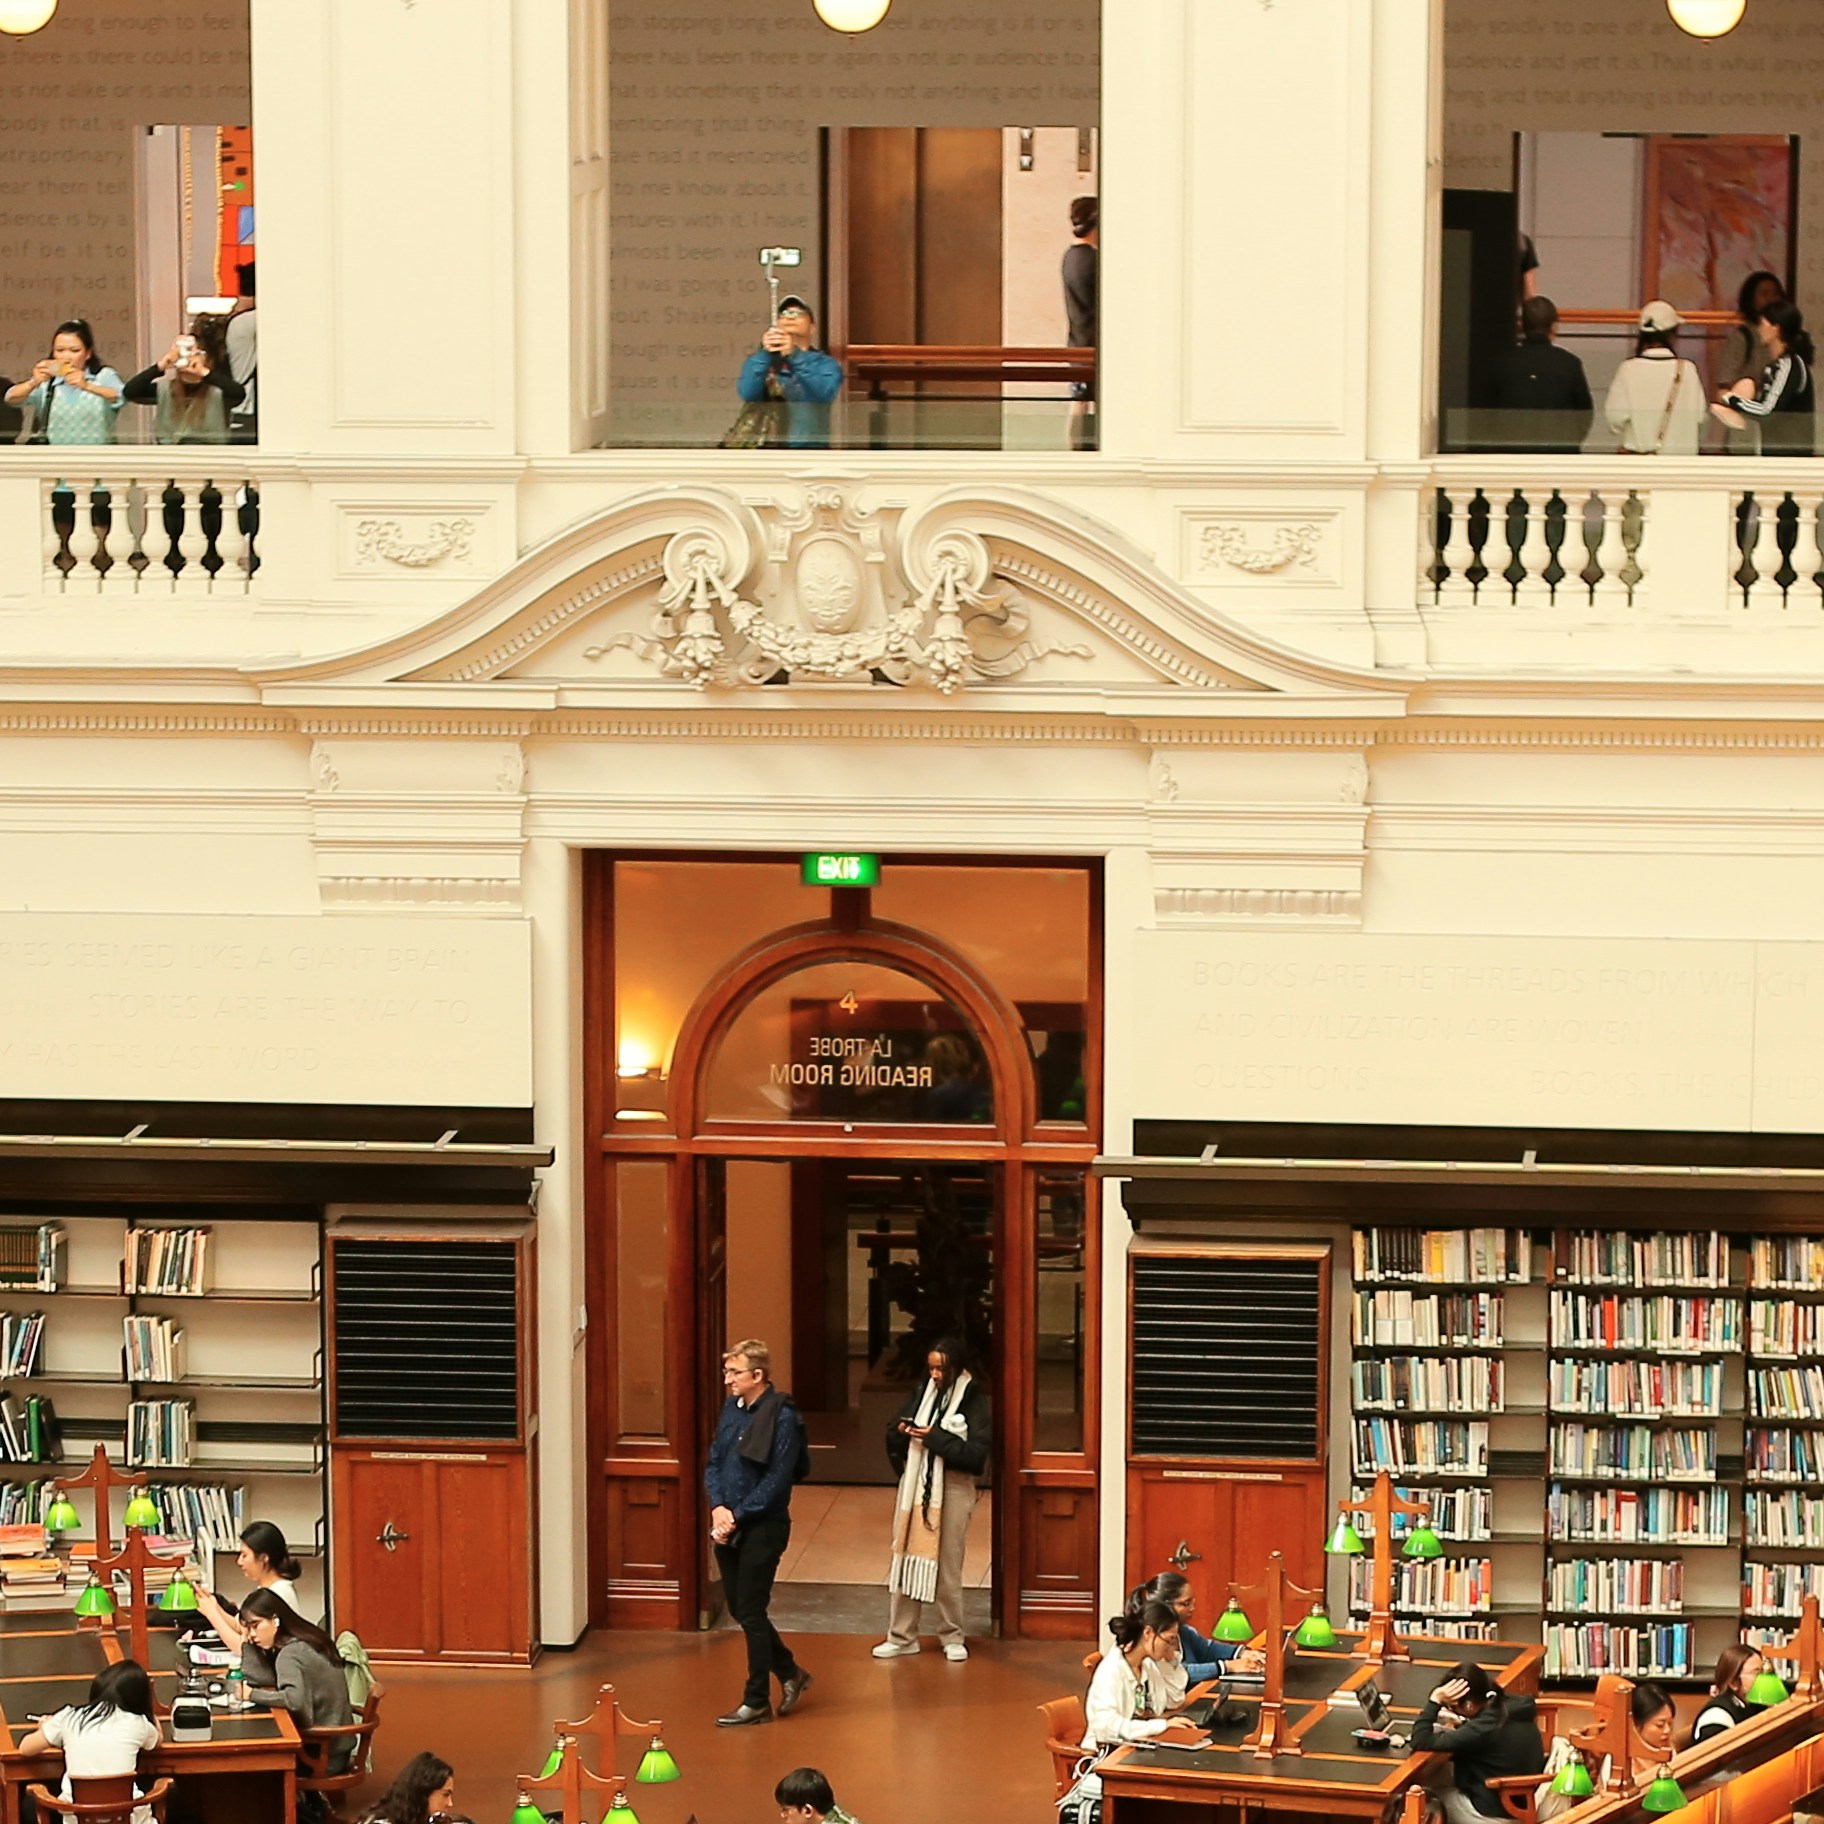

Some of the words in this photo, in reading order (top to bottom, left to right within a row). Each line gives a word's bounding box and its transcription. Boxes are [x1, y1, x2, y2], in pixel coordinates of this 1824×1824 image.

[59, 115, 99, 131] that
[38, 178, 89, 195] them
[97, 178, 129, 195] tell
[87, 209, 111, 231] by
[39, 241, 67, 259] be
[76, 242, 94, 259] it
[104, 242, 129, 259] to
[817, 857, 861, 881] EXIT
[1191, 959, 1299, 989] BOOKS
[1308, 961, 1368, 990] ARE
[1380, 963, 1435, 991] THE
[1447, 963, 1585, 994] THREADS
[1596, 965, 1686, 996] FROM
[839, 989, 859, 1016] 4
[1191, 1010, 1257, 1040] AND
[1267, 1011, 1453, 1043] CIVILIZATION
[1463, 1015, 1520, 1044] ARE
[1529, 1016, 1642, 1047] WOVEN
[1191, 1062, 1372, 1092] QUESTIONS
